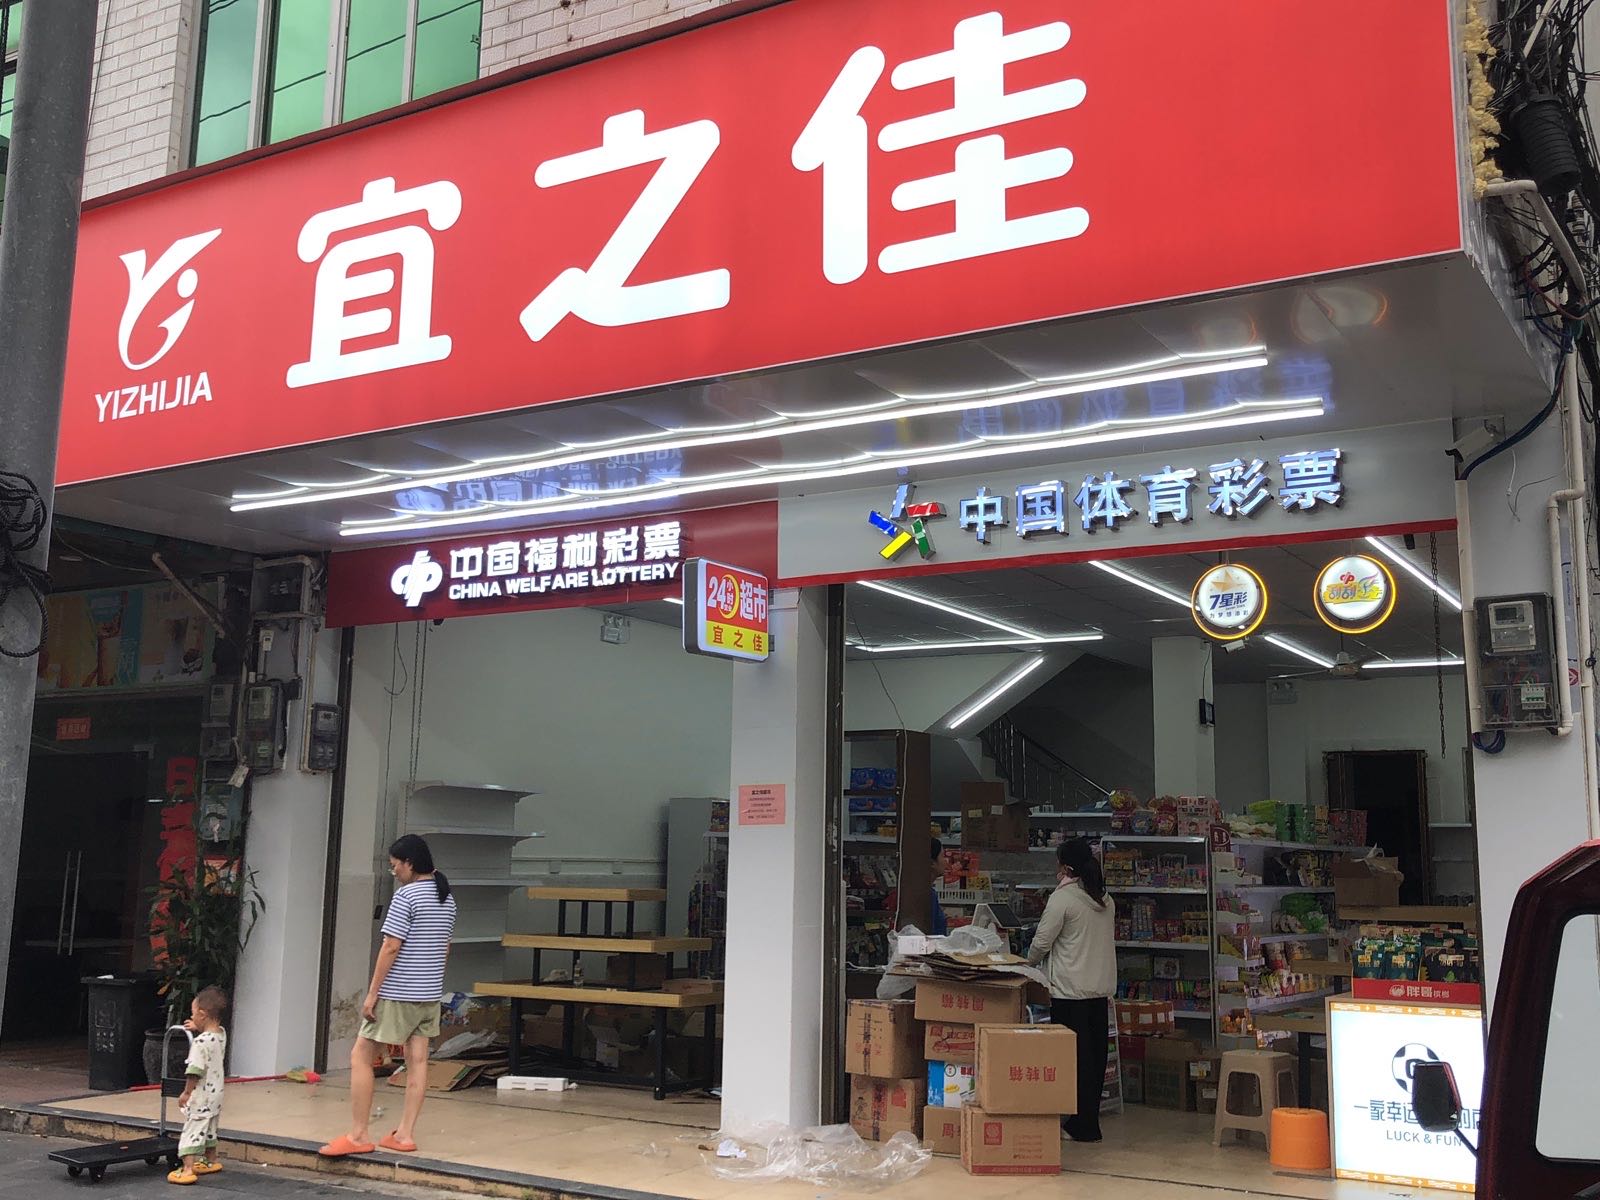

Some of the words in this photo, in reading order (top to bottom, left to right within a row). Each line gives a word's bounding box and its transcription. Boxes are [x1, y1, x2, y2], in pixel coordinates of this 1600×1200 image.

[286, 11, 1091, 389] 宜之佳
[95, 372, 213, 422] YIZHIJIA
[958, 447, 1343, 543] 中国体育彩票
[449, 521, 681, 580] 中国福利彩票
[448, 575, 501, 600] CHINA
[505, 572, 589, 595] WELFARE
[592, 562, 680, 586] LOTTERY
[1209, 591, 1248, 610] 7星彩
[713, 625, 763, 652] 宜之佳
[1008, 1066, 1056, 1082] 周转箱
[1386, 1130, 1420, 1143] LUCK
[1423, 1133, 1432, 1144] &
[1436, 1134, 1463, 1147] FUN
